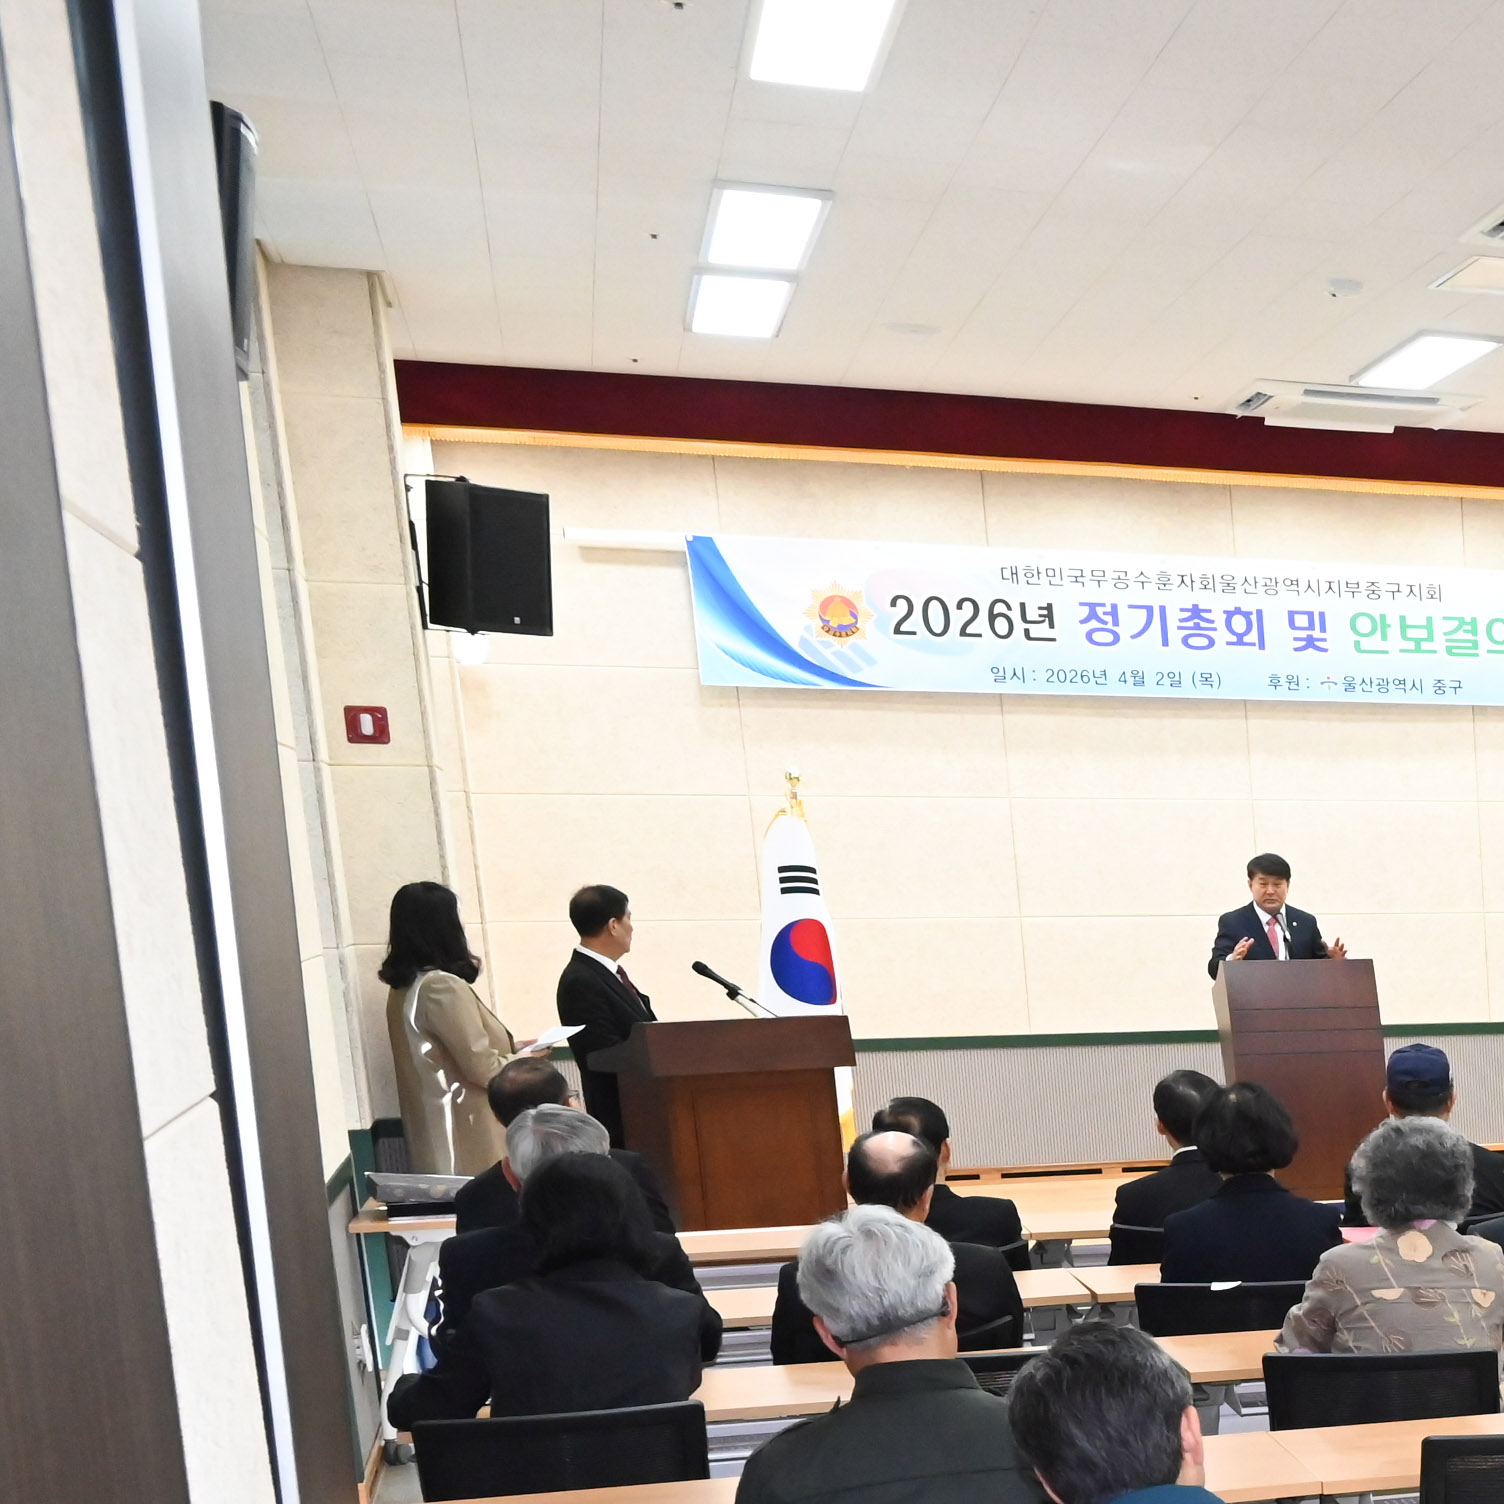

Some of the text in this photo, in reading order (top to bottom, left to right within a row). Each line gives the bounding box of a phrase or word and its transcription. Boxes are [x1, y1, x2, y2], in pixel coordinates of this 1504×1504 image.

[1000, 565, 1442, 602] 대한민국무공수훈자회울산광역시지부중구지회
[890, 595, 1057, 642] 2026년
[1078, 601, 1266, 651] 정기총회
[1287, 609, 1329, 653] 및
[1045, 667, 1108, 686] 2026년
[1117, 669, 1146, 687] 4월
[1155, 671, 1183, 688] 2일
[1191, 670, 1222, 690] (목)
[1342, 675, 1424, 695] 울산광역시
[1432, 678, 1464, 695] 중구
